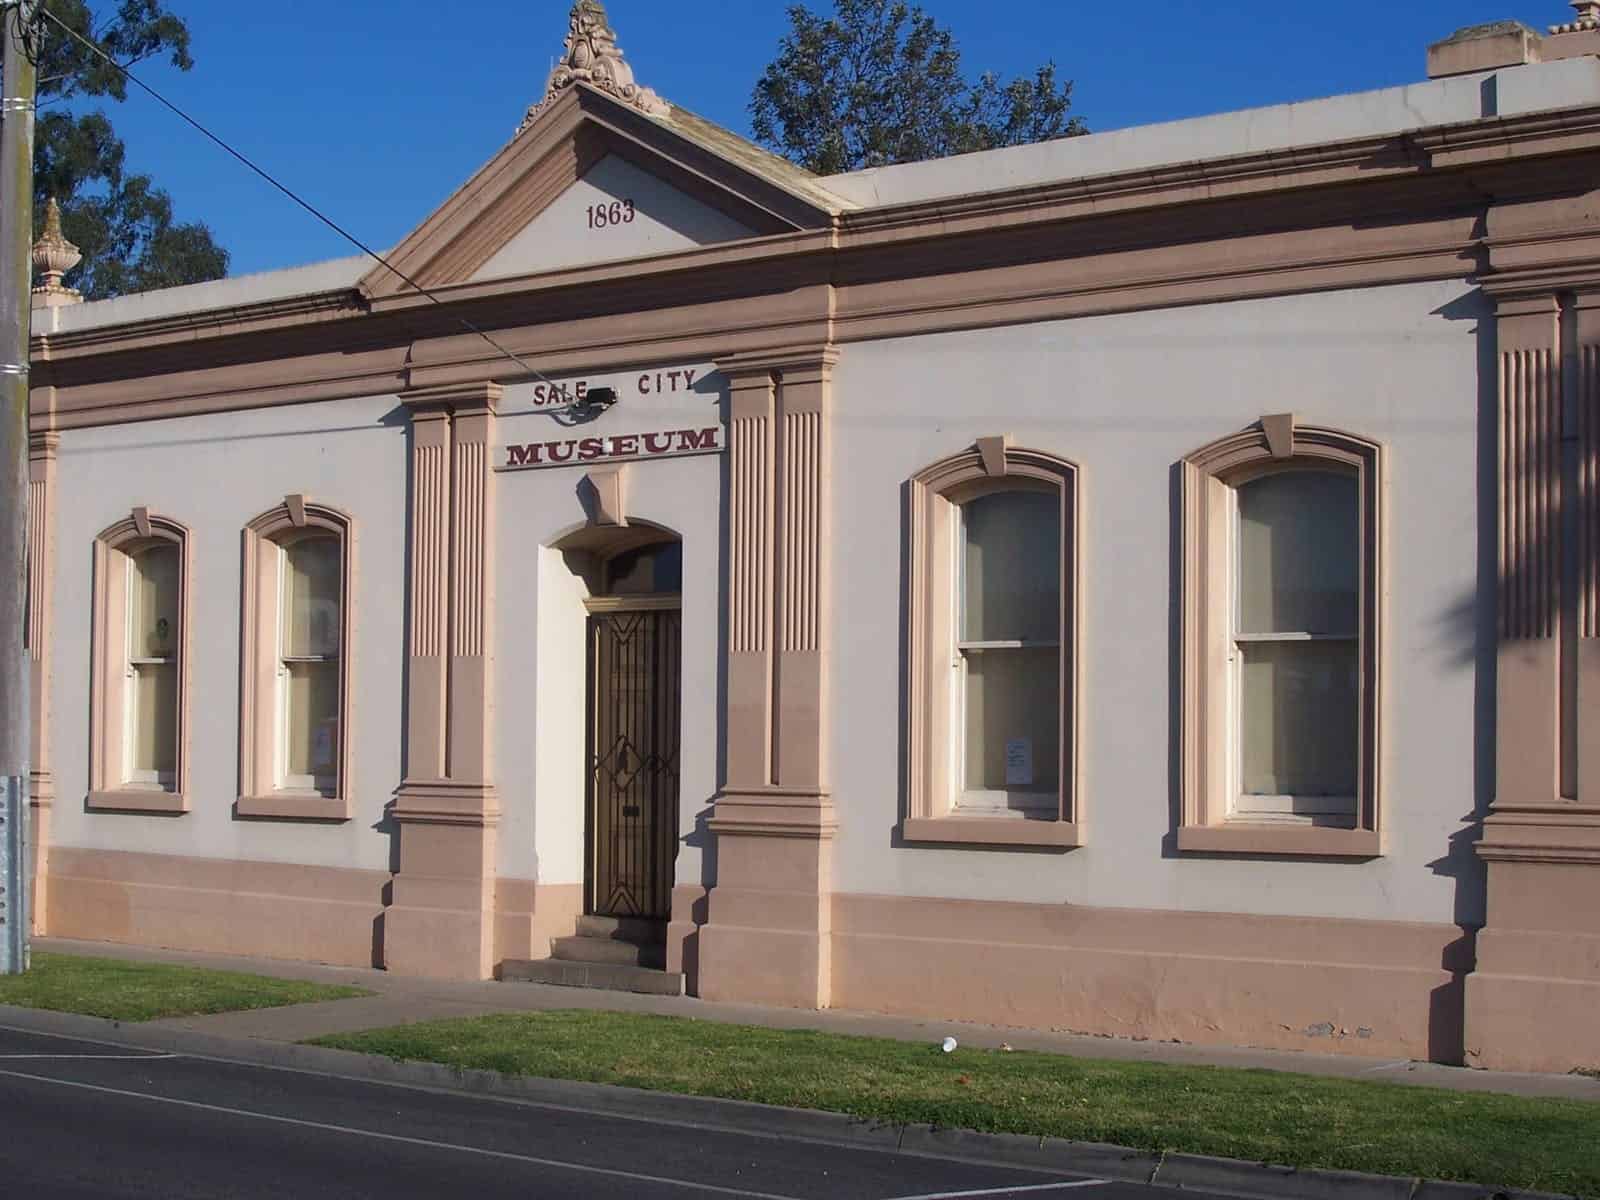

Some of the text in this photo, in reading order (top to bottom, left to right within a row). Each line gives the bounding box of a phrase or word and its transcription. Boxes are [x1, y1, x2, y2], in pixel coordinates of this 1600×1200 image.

[586, 199, 634, 229] 1863
[533, 369, 696, 405] SALE CITY
[506, 427, 719, 466] MUSEUM
